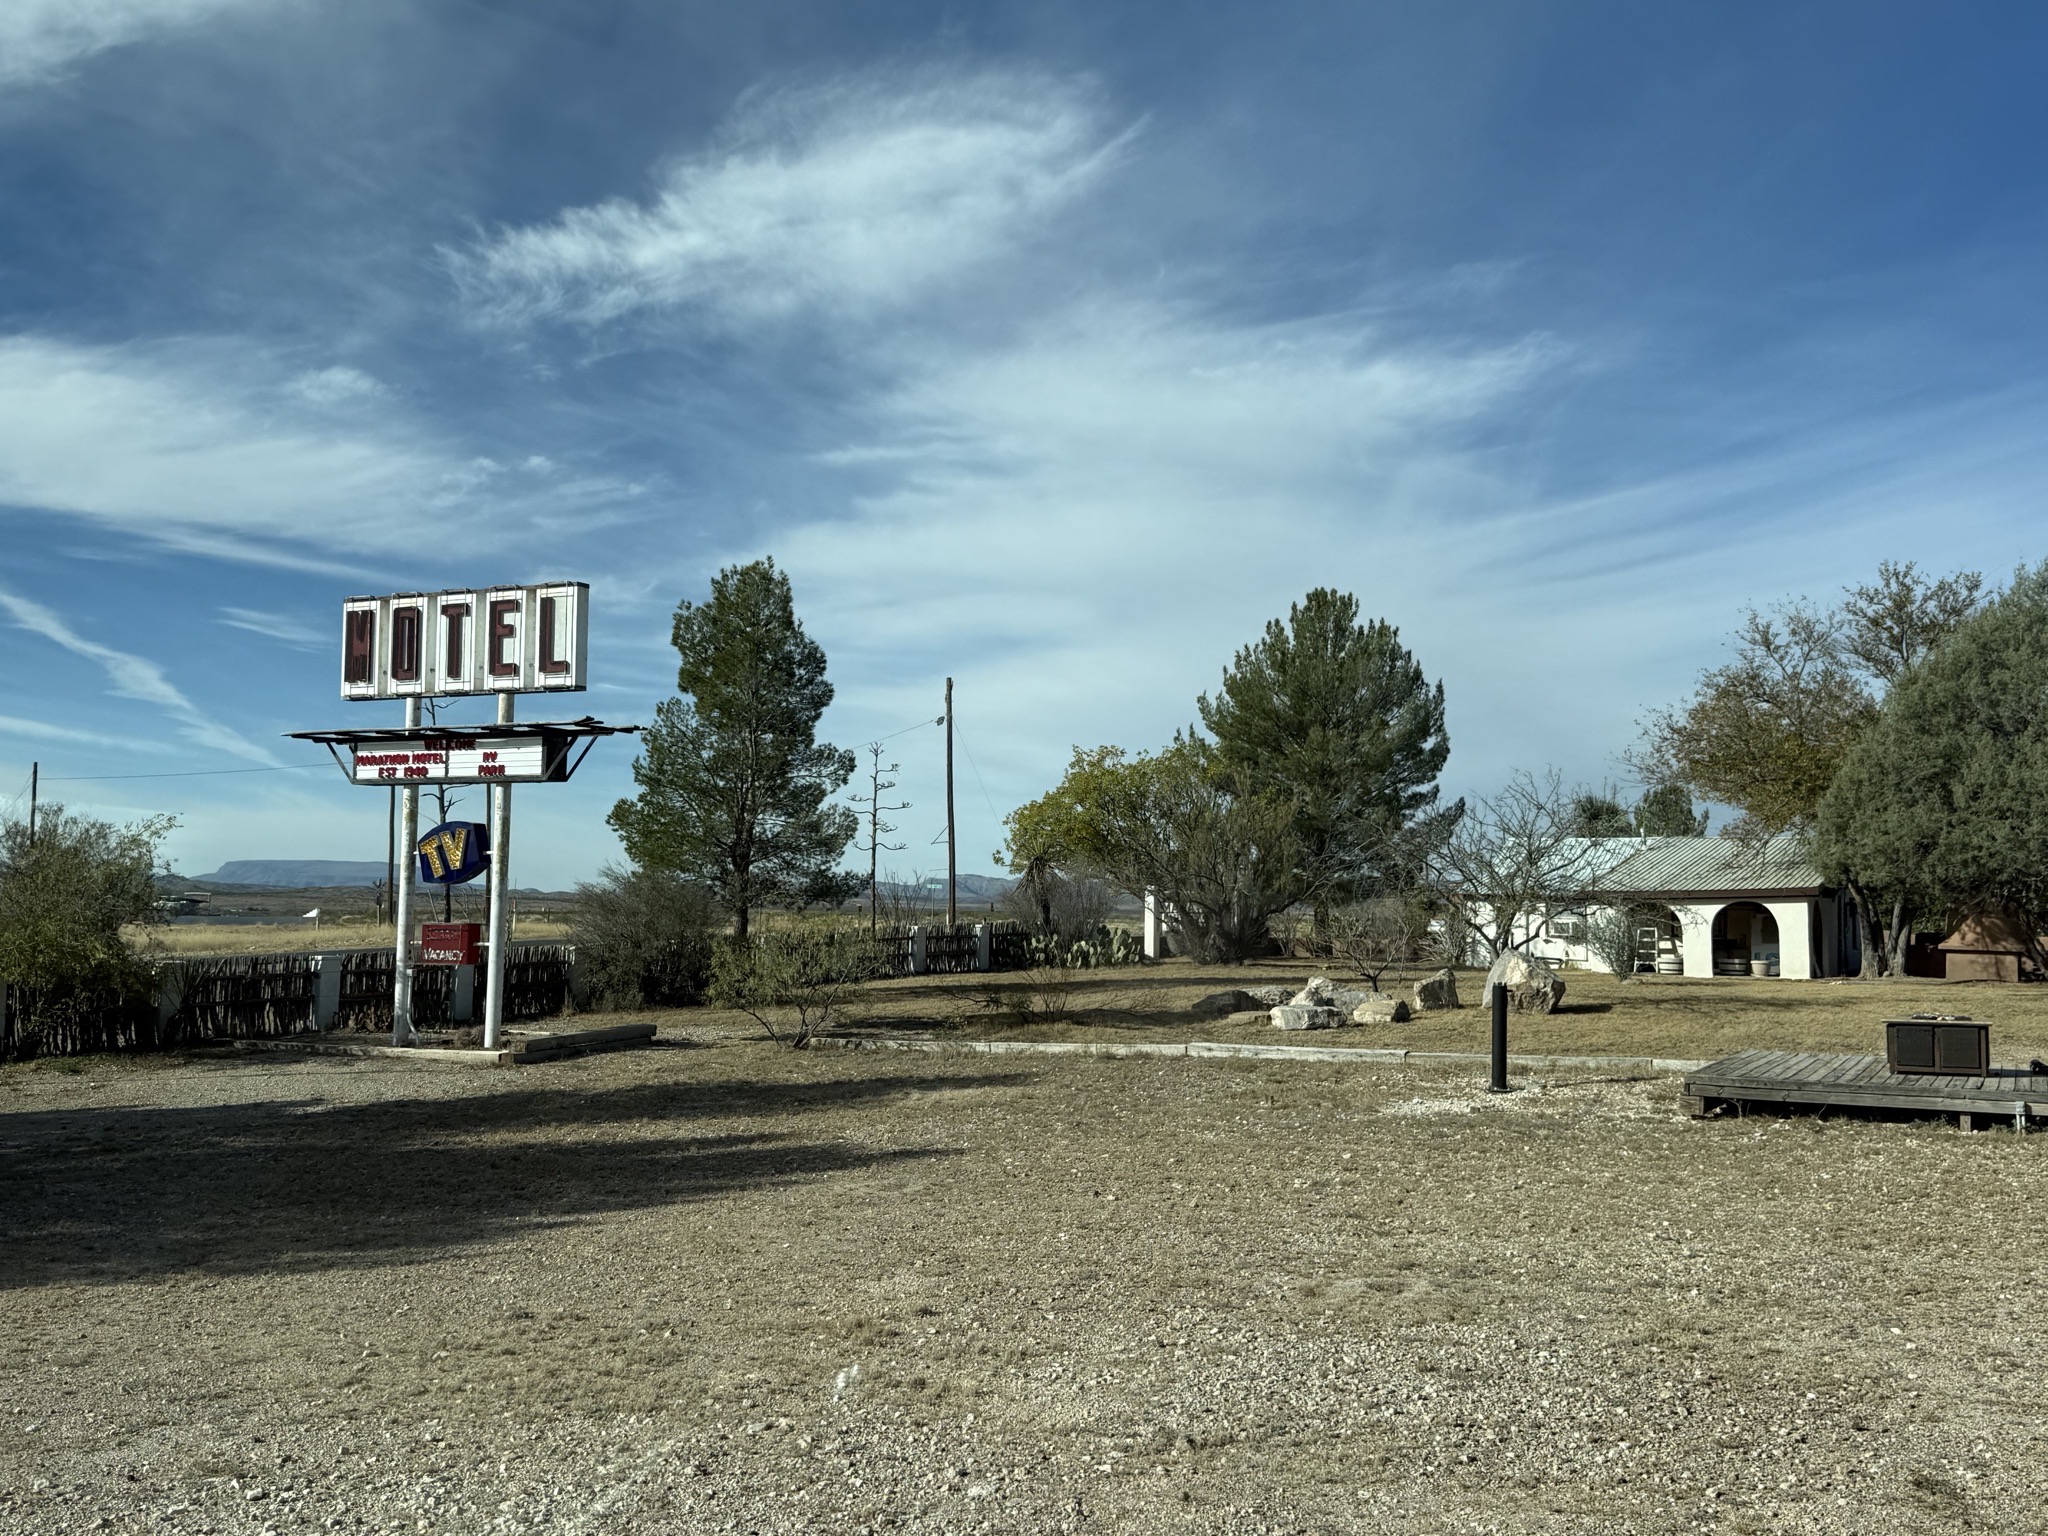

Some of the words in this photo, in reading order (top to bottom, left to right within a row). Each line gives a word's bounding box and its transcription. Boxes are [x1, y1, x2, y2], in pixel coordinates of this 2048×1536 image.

[344, 597, 571, 683] MOTEL
[424, 738, 476, 751] WELCOME
[356, 754, 410, 766] MARATHON
[483, 751, 498, 763] RV
[378, 767, 398, 778] EST
[478, 765, 505, 776] PARK
[419, 828, 467, 878] TV
[423, 948, 465, 961] VACANCY
